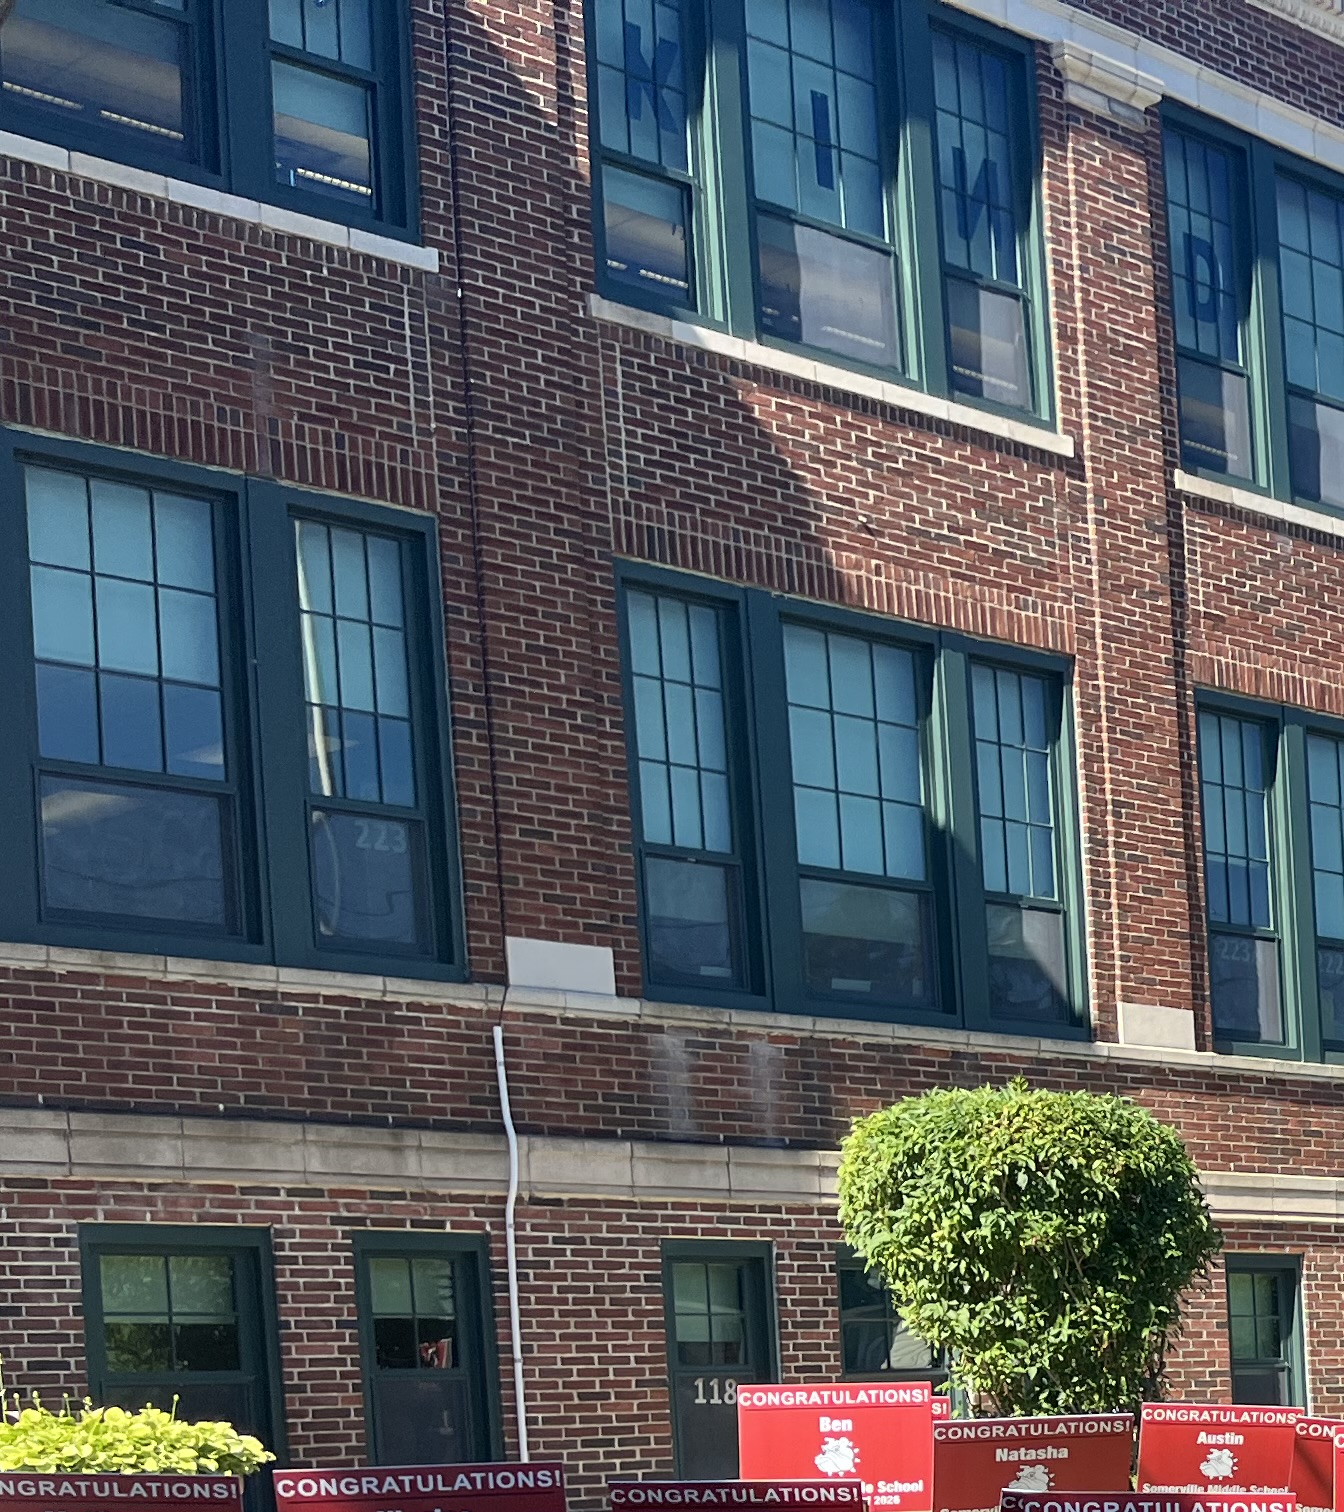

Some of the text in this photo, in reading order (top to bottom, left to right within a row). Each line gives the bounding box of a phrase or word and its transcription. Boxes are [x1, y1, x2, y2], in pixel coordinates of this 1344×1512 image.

[695, 1378, 736, 1404] 118
[739, 1389, 928, 1406] CONGRATULATIONS!
[820, 1417, 852, 1432] Ben
[934, 1421, 1129, 1439] CONGRATULATIONS!
[1197, 1432, 1244, 1445] Austin
[996, 1446, 1068, 1461] Natasha
[0, 1480, 236, 1498] NGRATULATIONS!
[276, 1470, 560, 1497] CONGRATULATIONS!
[878, 1480, 923, 1493] School
[609, 1487, 858, 1502] CONGRATULATIONS!
